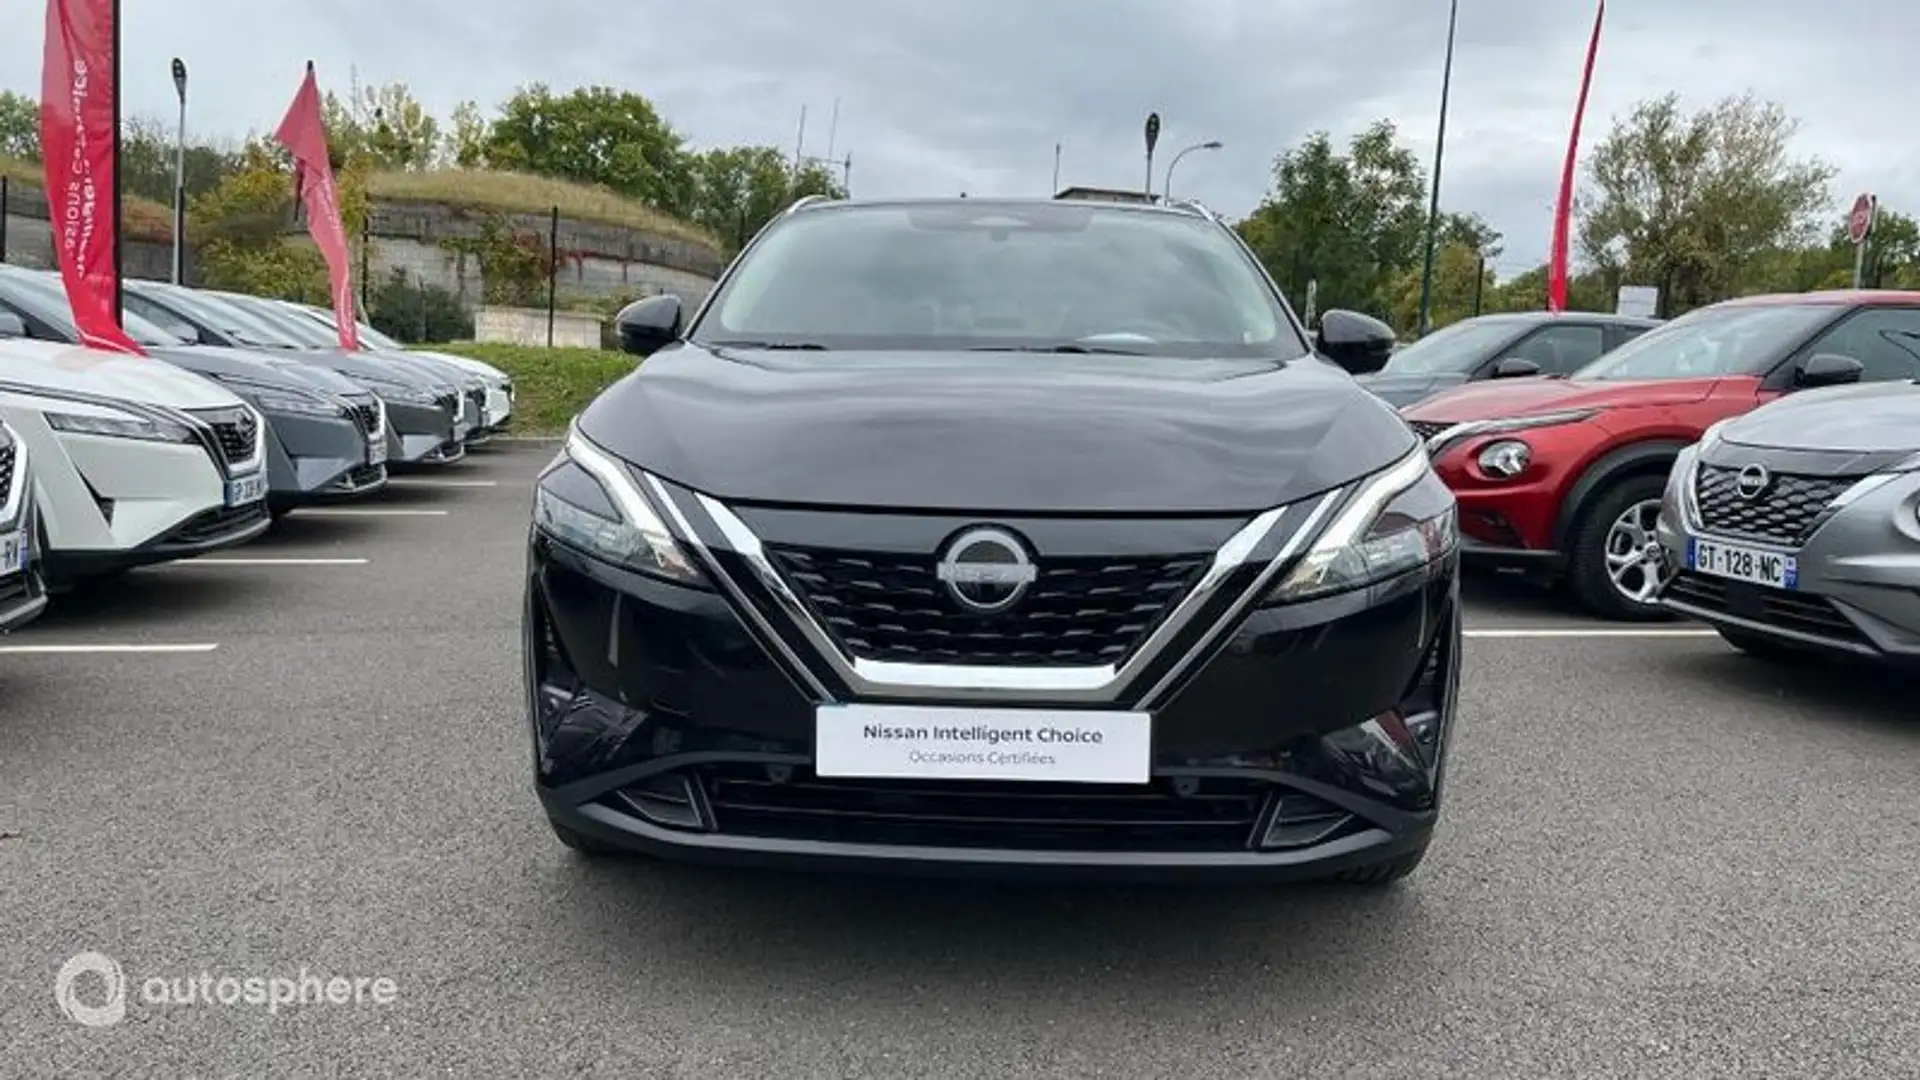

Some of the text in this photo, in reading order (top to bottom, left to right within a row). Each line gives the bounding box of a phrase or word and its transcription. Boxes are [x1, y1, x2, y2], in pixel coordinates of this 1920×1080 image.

[1699, 544, 1781, 582] GT-128-NC
[863, 723, 1104, 745] Nissan Intelligent Choice
[909, 751, 1057, 766] Occasions Certifiées
